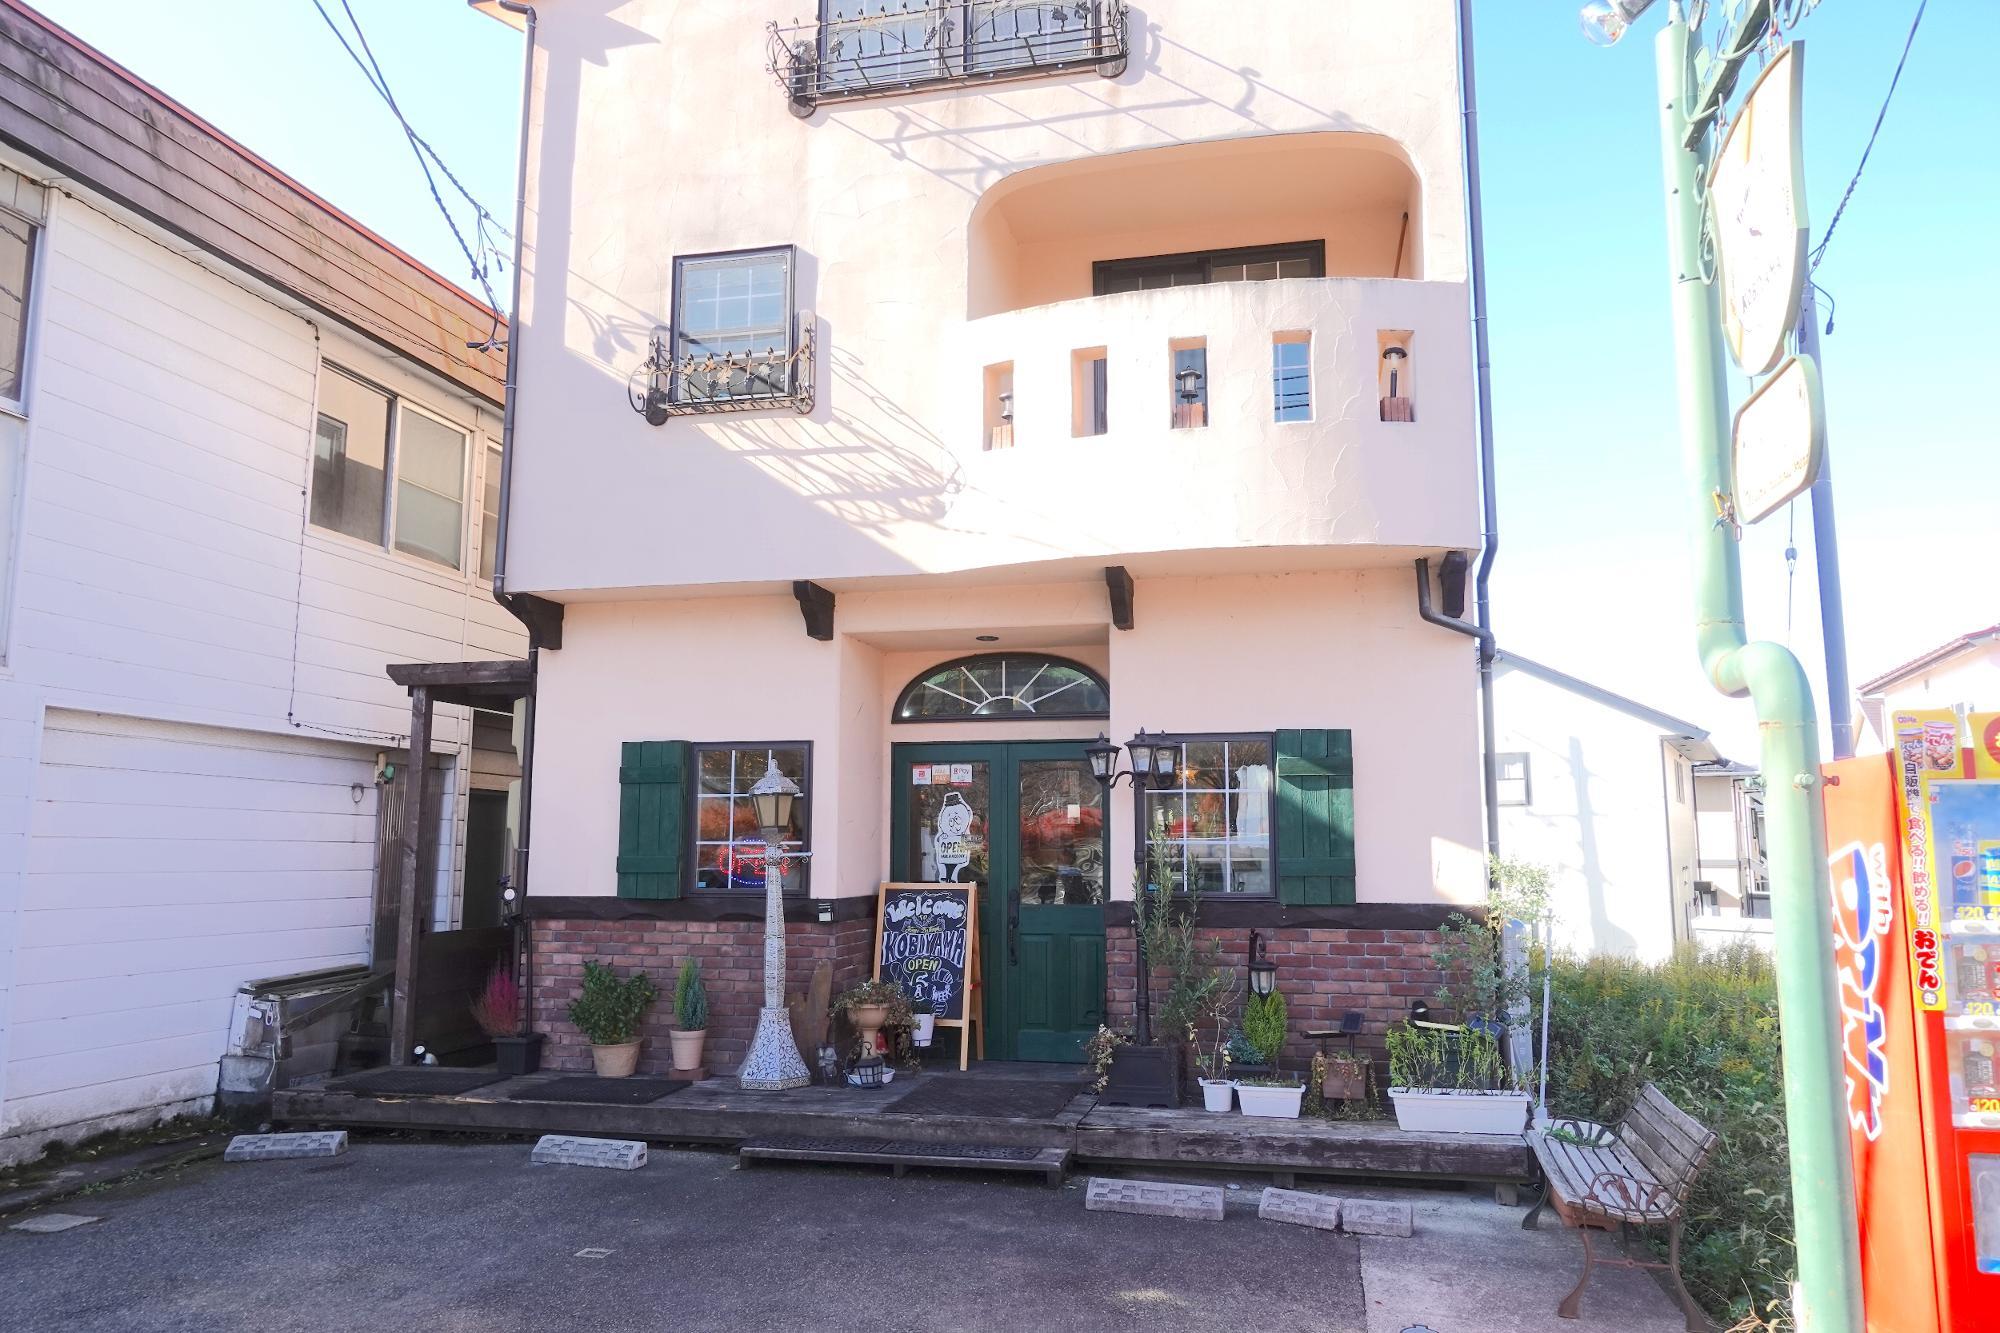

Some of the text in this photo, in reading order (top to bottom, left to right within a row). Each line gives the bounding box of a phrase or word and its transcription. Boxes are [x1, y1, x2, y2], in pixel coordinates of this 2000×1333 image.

[908, 959, 938, 971] OPEN
[1967, 1002, 1993, 1015] 120
[1973, 1098, 2000, 1112] 120
